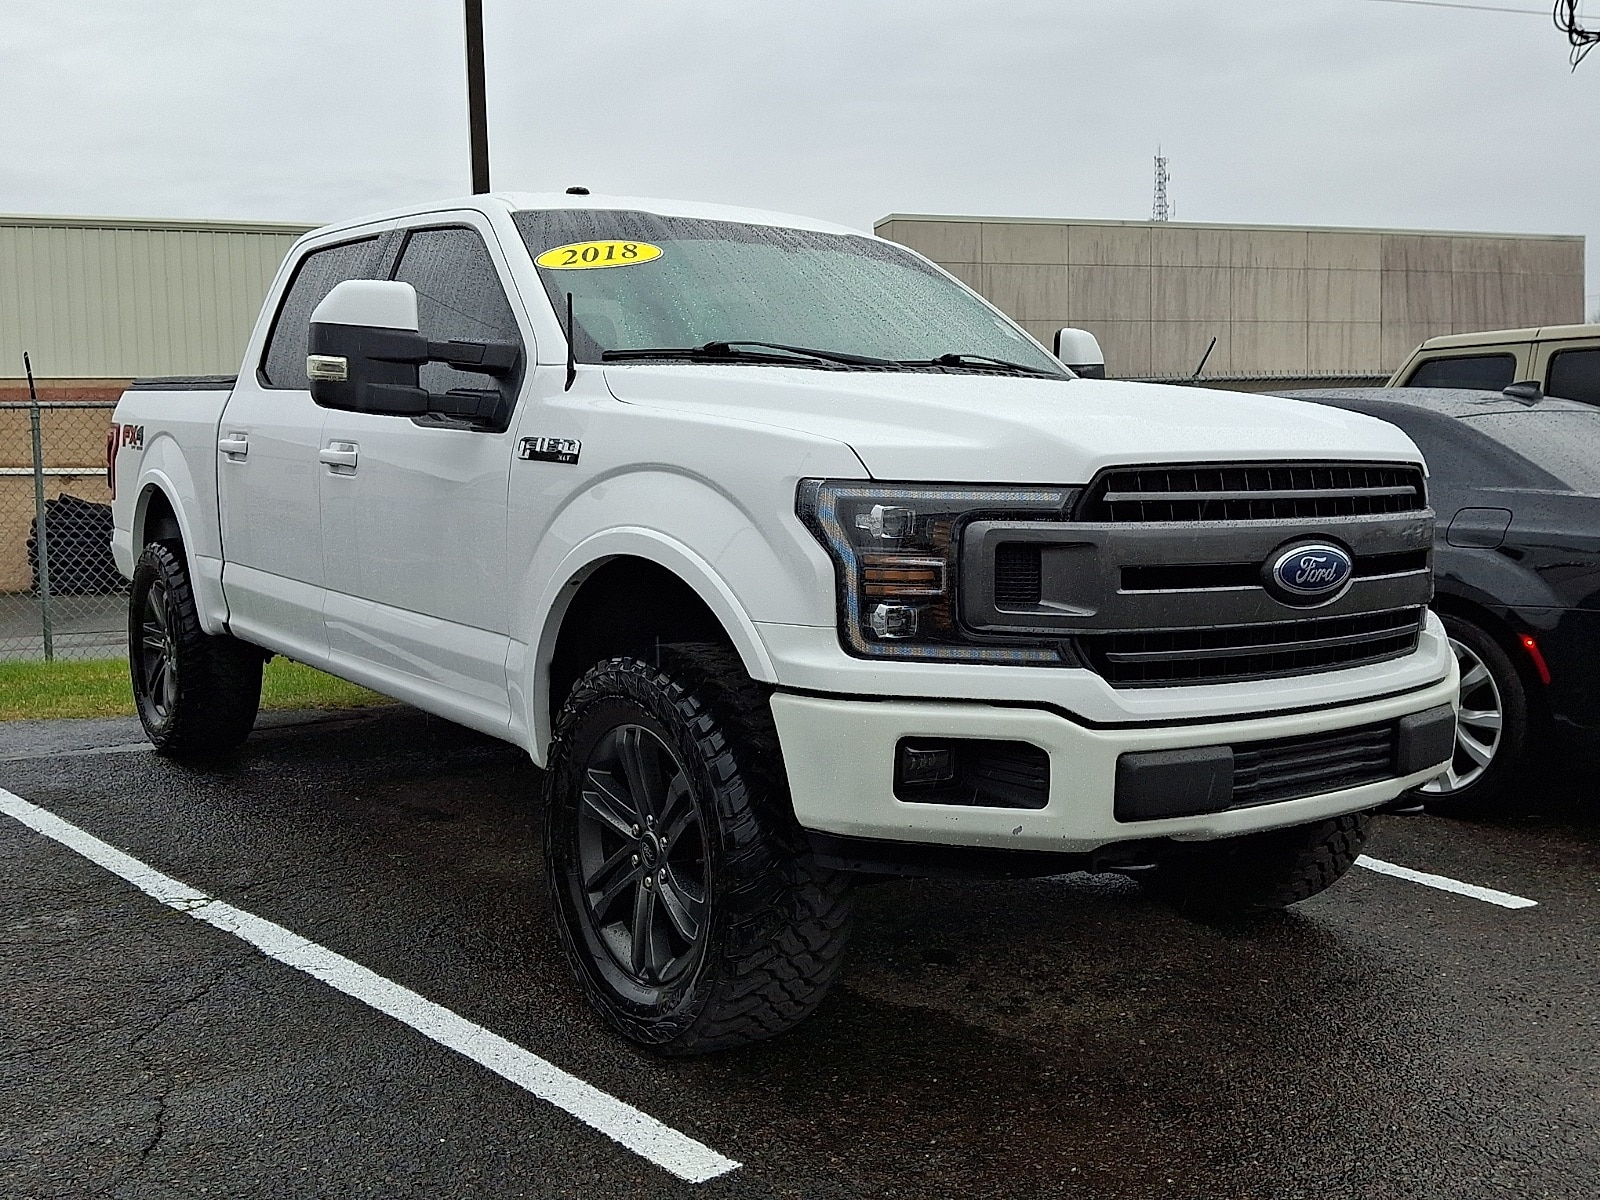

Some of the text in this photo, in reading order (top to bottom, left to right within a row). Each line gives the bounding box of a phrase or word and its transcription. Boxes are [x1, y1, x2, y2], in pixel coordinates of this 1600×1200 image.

[561, 243, 638, 266] 2018
[122, 424, 145, 447] FX4
[557, 454, 572, 462] XLT
[1295, 556, 1338, 584] Ford
